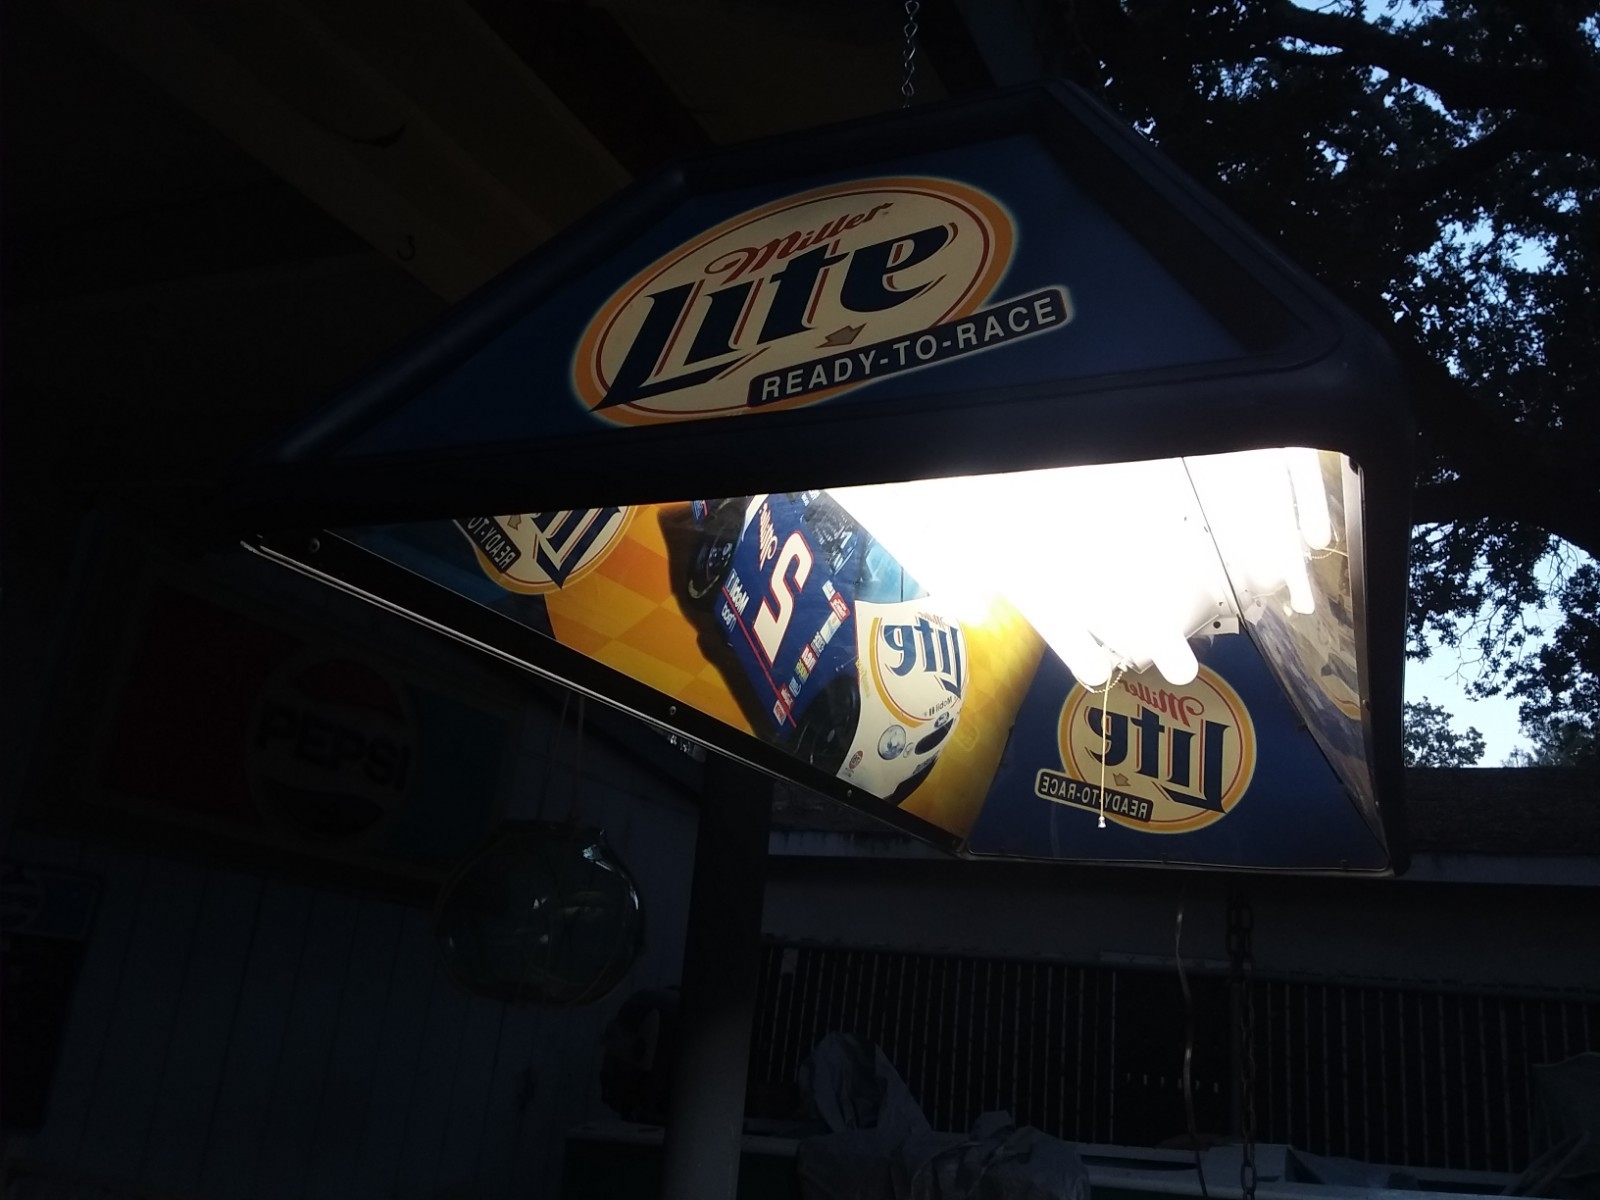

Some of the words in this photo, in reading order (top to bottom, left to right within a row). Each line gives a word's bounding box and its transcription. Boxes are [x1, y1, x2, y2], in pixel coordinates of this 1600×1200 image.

[705, 202, 893, 285] Miller
[588, 222, 958, 413] Lite
[760, 297, 1056, 401] READY-TO-RACE
[255, 700, 410, 791] PEPSI
